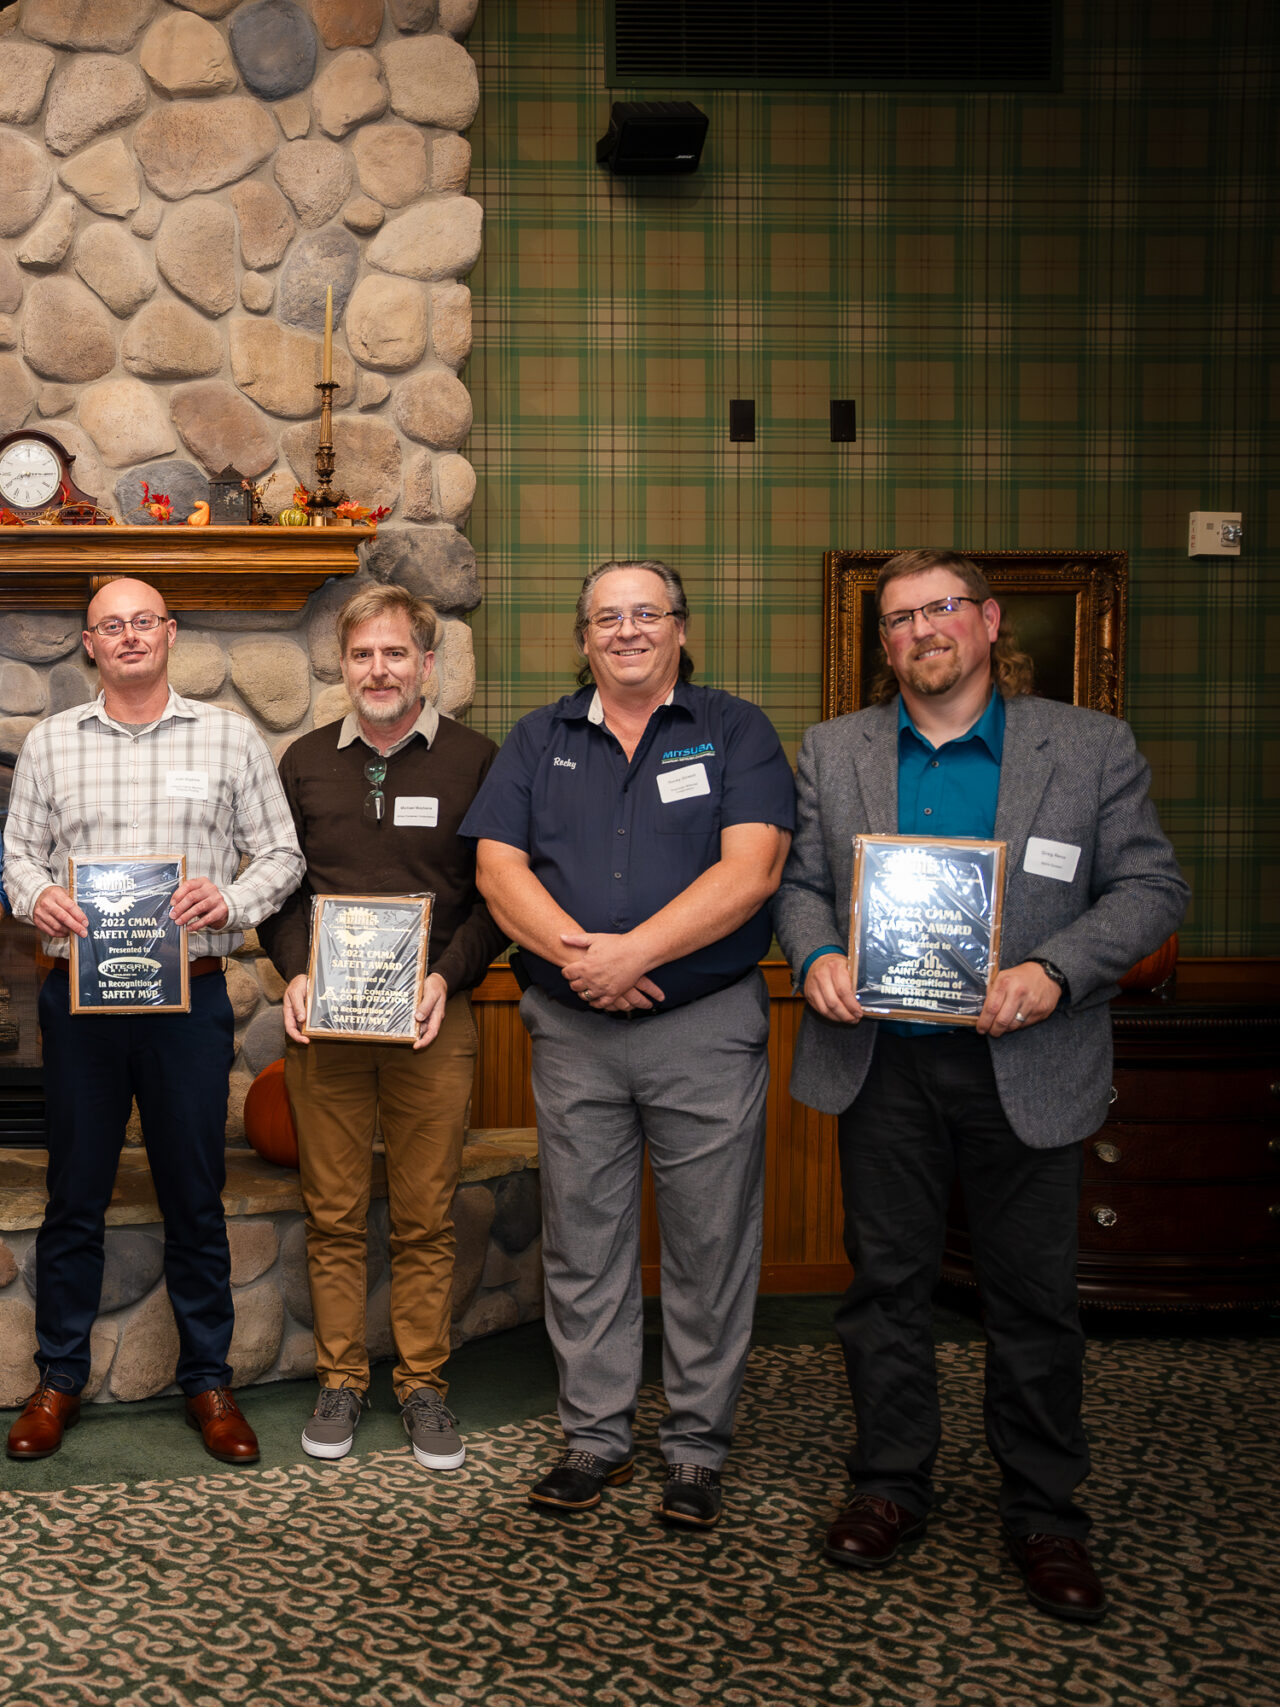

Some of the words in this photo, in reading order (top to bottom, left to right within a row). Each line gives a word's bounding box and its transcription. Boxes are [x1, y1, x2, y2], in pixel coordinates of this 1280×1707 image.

[662, 743, 714, 759] MITSUBA
[554, 757, 576, 770] Rocky
[925, 909, 963, 921] CMMA
[101, 918, 125, 927] 2022
[128, 917, 157, 927] CMMA
[93, 930, 129, 939] SAFETY
[131, 929, 166, 939] AWARD
[927, 923, 972, 936] AWARD
[108, 946, 142, 954] Presented
[942, 942, 951, 950] to
[341, 950, 364, 958] 2022
[366, 951, 395, 960] CMMA
[332, 959, 365, 969] SAFETY
[368, 961, 402, 971] AWARD
[888, 966, 958, 978] SAINT-GOBAIN
[108, 979, 152, 989] Recognition
[345, 975, 377, 983] Presented
[379, 976, 386, 984] to
[881, 974, 892, 983] In
[894, 976, 950, 988] Recognition
[952, 981, 962, 989] of
[102, 990, 136, 999] SAFETY
[137, 990, 158, 999] MVP
[364, 989, 410, 997] CONTAINER
[881, 985, 928, 997] INDUSTRY
[928, 989, 962, 999] SAFETY
[340, 994, 409, 1004] CORPORATION
[902, 997, 938, 1008] LEADER
[340, 1006, 384, 1014] Recognition
[333, 1015, 366, 1024] SAFETY
[368, 1017, 389, 1025] MVP
